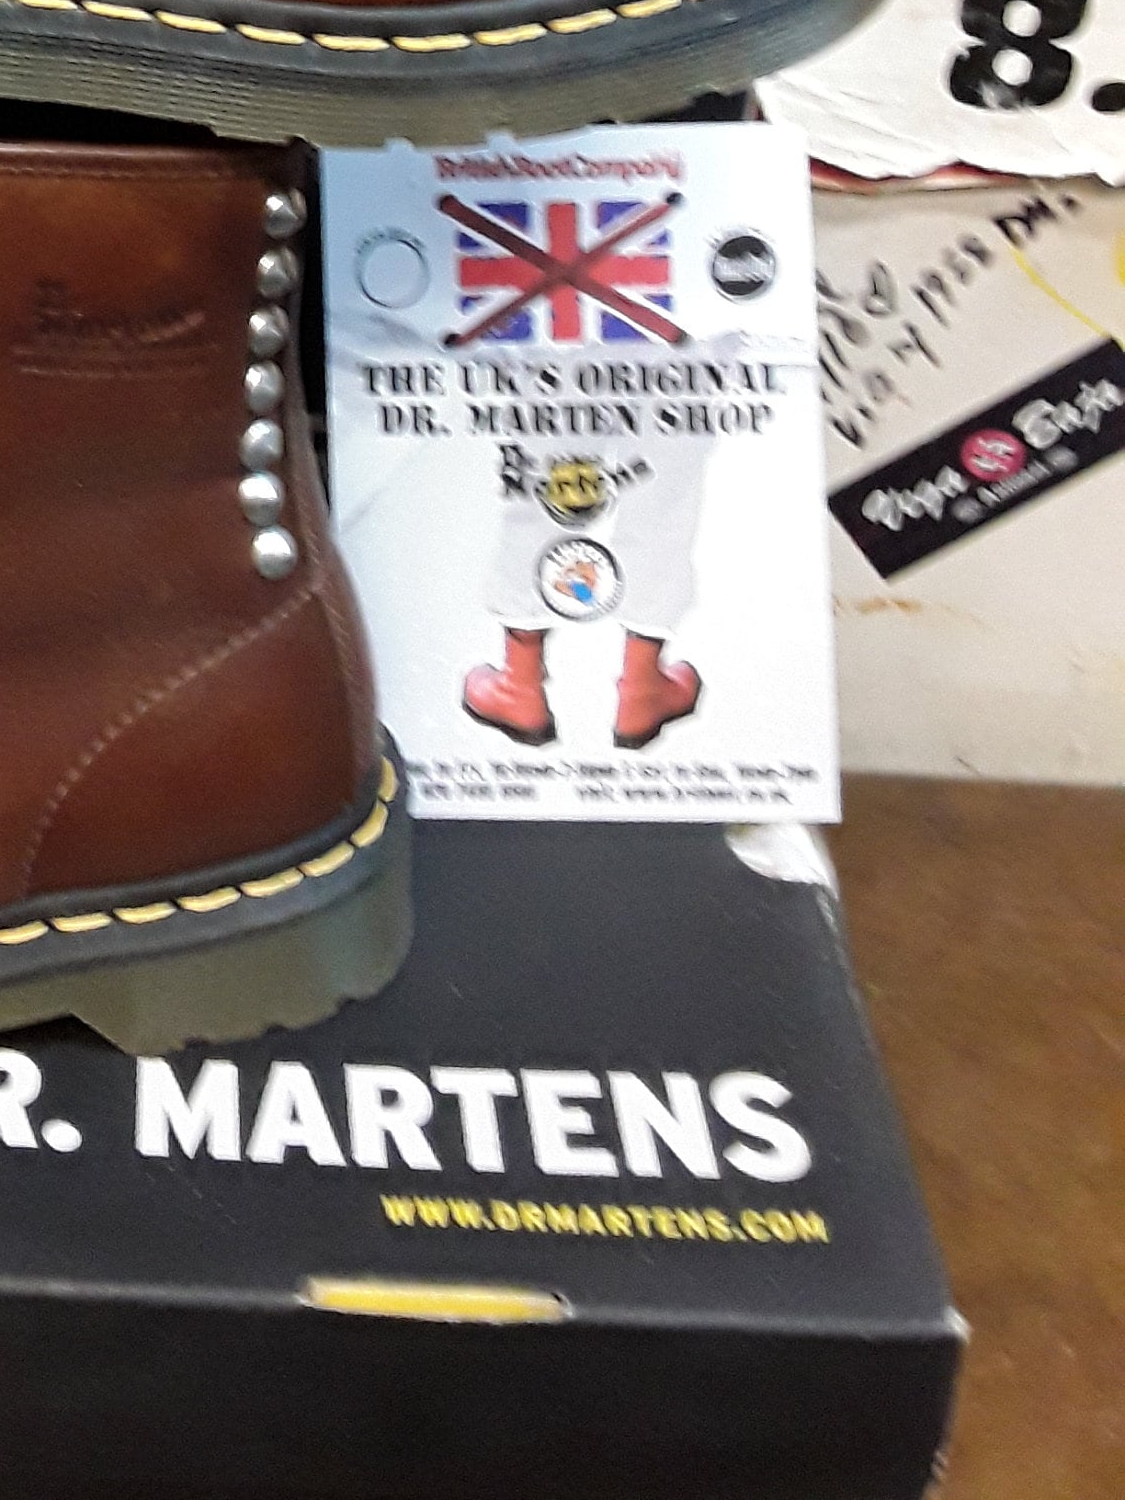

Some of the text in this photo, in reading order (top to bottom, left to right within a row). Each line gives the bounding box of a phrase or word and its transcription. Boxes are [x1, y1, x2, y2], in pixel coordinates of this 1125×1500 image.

[363, 362, 444, 396] THE
[578, 361, 785, 396] ORIGINAL
[379, 405, 774, 436] DR. MARTEN SHOP
[134, 1053, 813, 1184] MARTENS
[378, 1194, 831, 1244] WWW.DRMARTENS.COM
